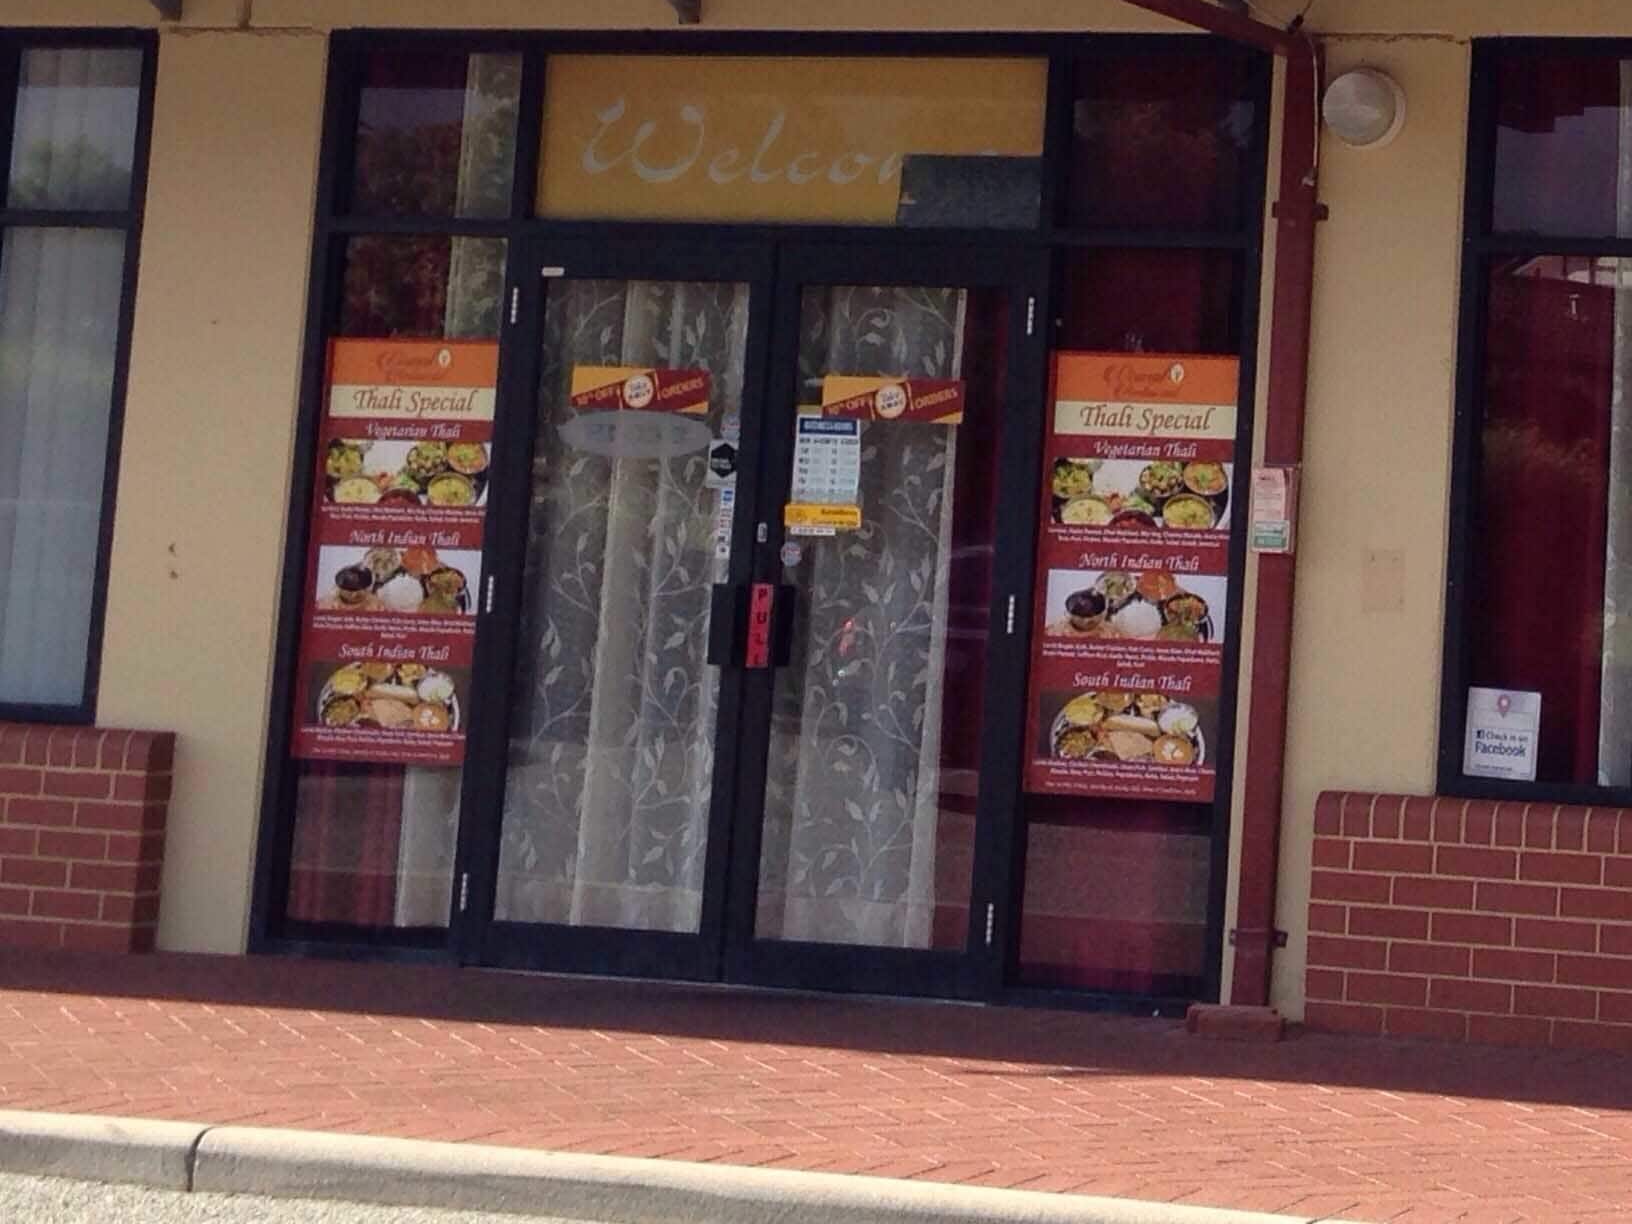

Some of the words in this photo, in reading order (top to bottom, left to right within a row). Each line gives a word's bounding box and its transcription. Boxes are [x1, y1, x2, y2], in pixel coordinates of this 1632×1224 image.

[581, 98, 905, 186] Welco
[353, 388, 403, 410] Thali
[405, 389, 479, 418] Special
[1080, 404, 1134, 428] Thali
[1136, 406, 1217, 435] Special
[366, 423, 428, 440] Vegetarian
[430, 423, 462, 438] Thali
[1093, 440, 1161, 459] Vegetarian
[1163, 442, 1198, 458] Thali
[350, 529, 386, 545] North
[387, 531, 428, 546] Indian
[430, 532, 461, 546] Thali
[1079, 552, 1118, 569] North
[1121, 554, 1163, 570] Indian
[1165, 555, 1200, 572] Thali
[338, 643, 375, 659] South
[377, 645, 416, 659] Indian
[418, 646, 450, 661] Thali
[1072, 672, 1110, 688] South
[1112, 674, 1155, 690] Indian
[1158, 675, 1193, 692] Thali
[1475, 741, 1526, 757] Facebook
